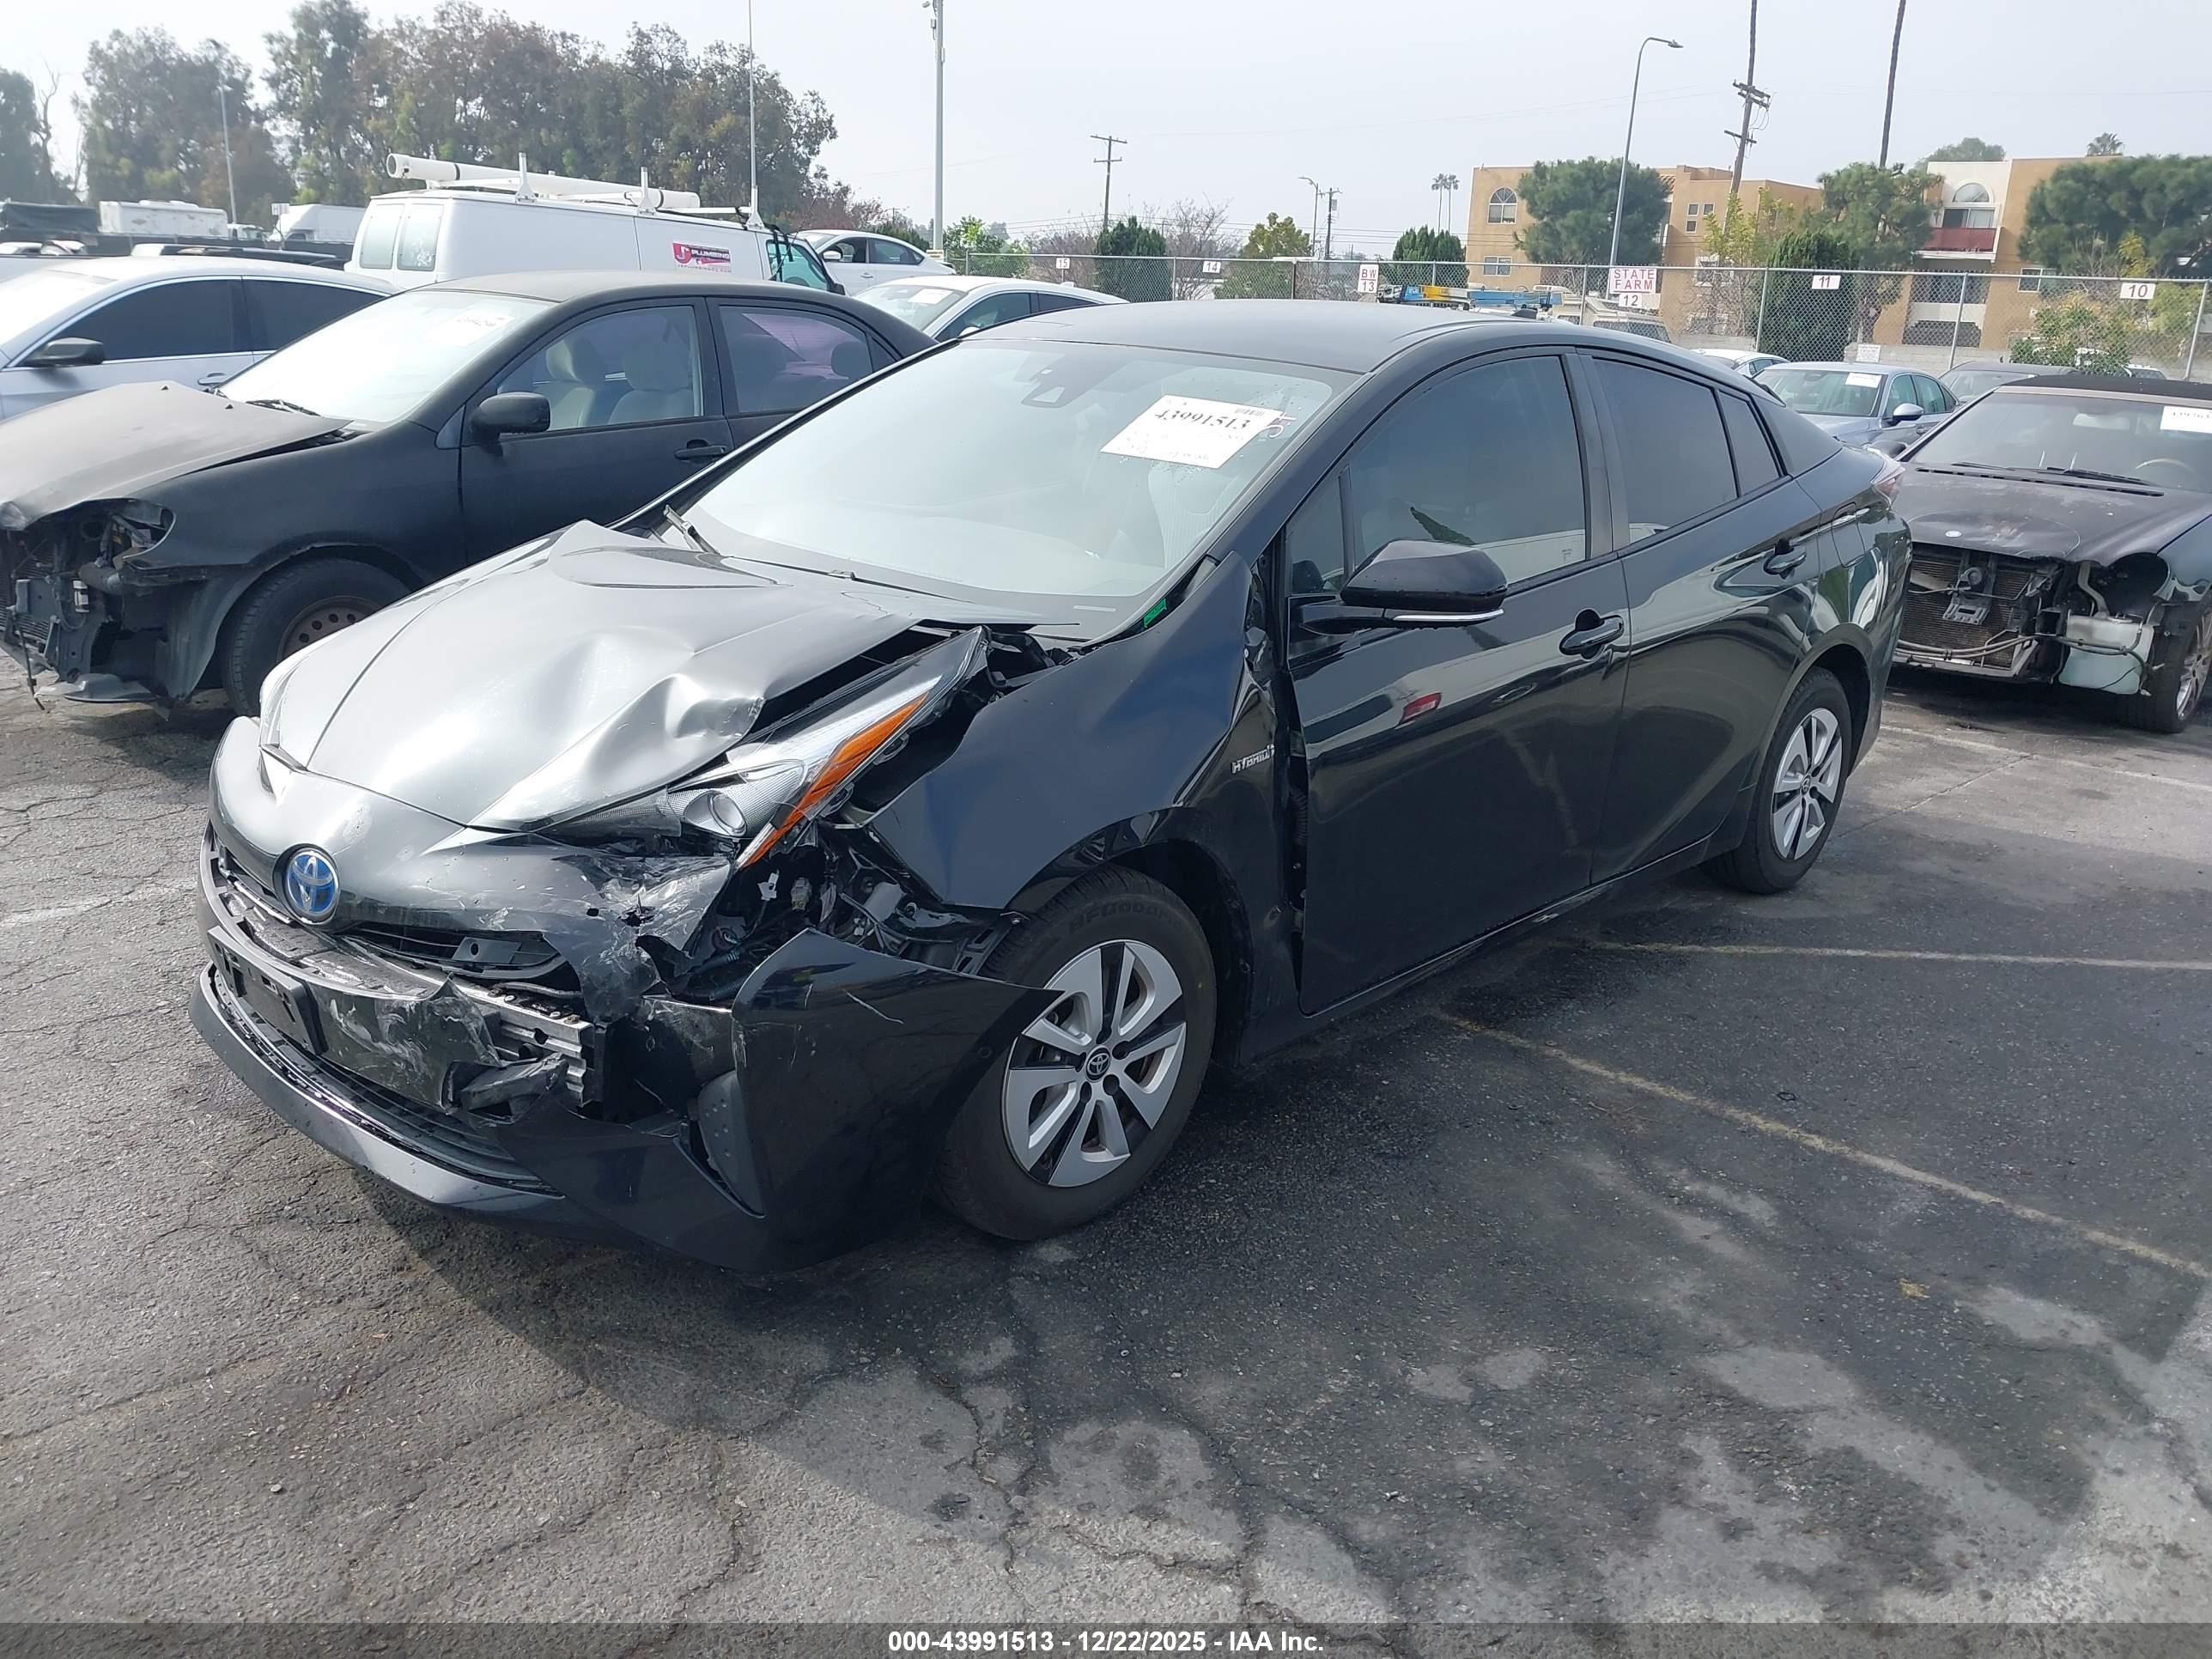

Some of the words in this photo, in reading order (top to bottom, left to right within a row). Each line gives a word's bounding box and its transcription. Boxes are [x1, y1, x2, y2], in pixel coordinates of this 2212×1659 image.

[691, 248, 730, 259] PLUMBING
[1059, 258, 1067, 268] 15
[1206, 262, 1218, 271] 14
[1361, 268, 1376, 278] BW
[1613, 269, 1655, 280] STATE
[1362, 281, 1375, 292] 13
[1614, 279, 1653, 290] FARM
[1819, 276, 1830, 289] 11
[2129, 284, 2148, 298] 10
[1623, 294, 1638, 307] 12
[1154, 410, 1251, 430] 43991513
